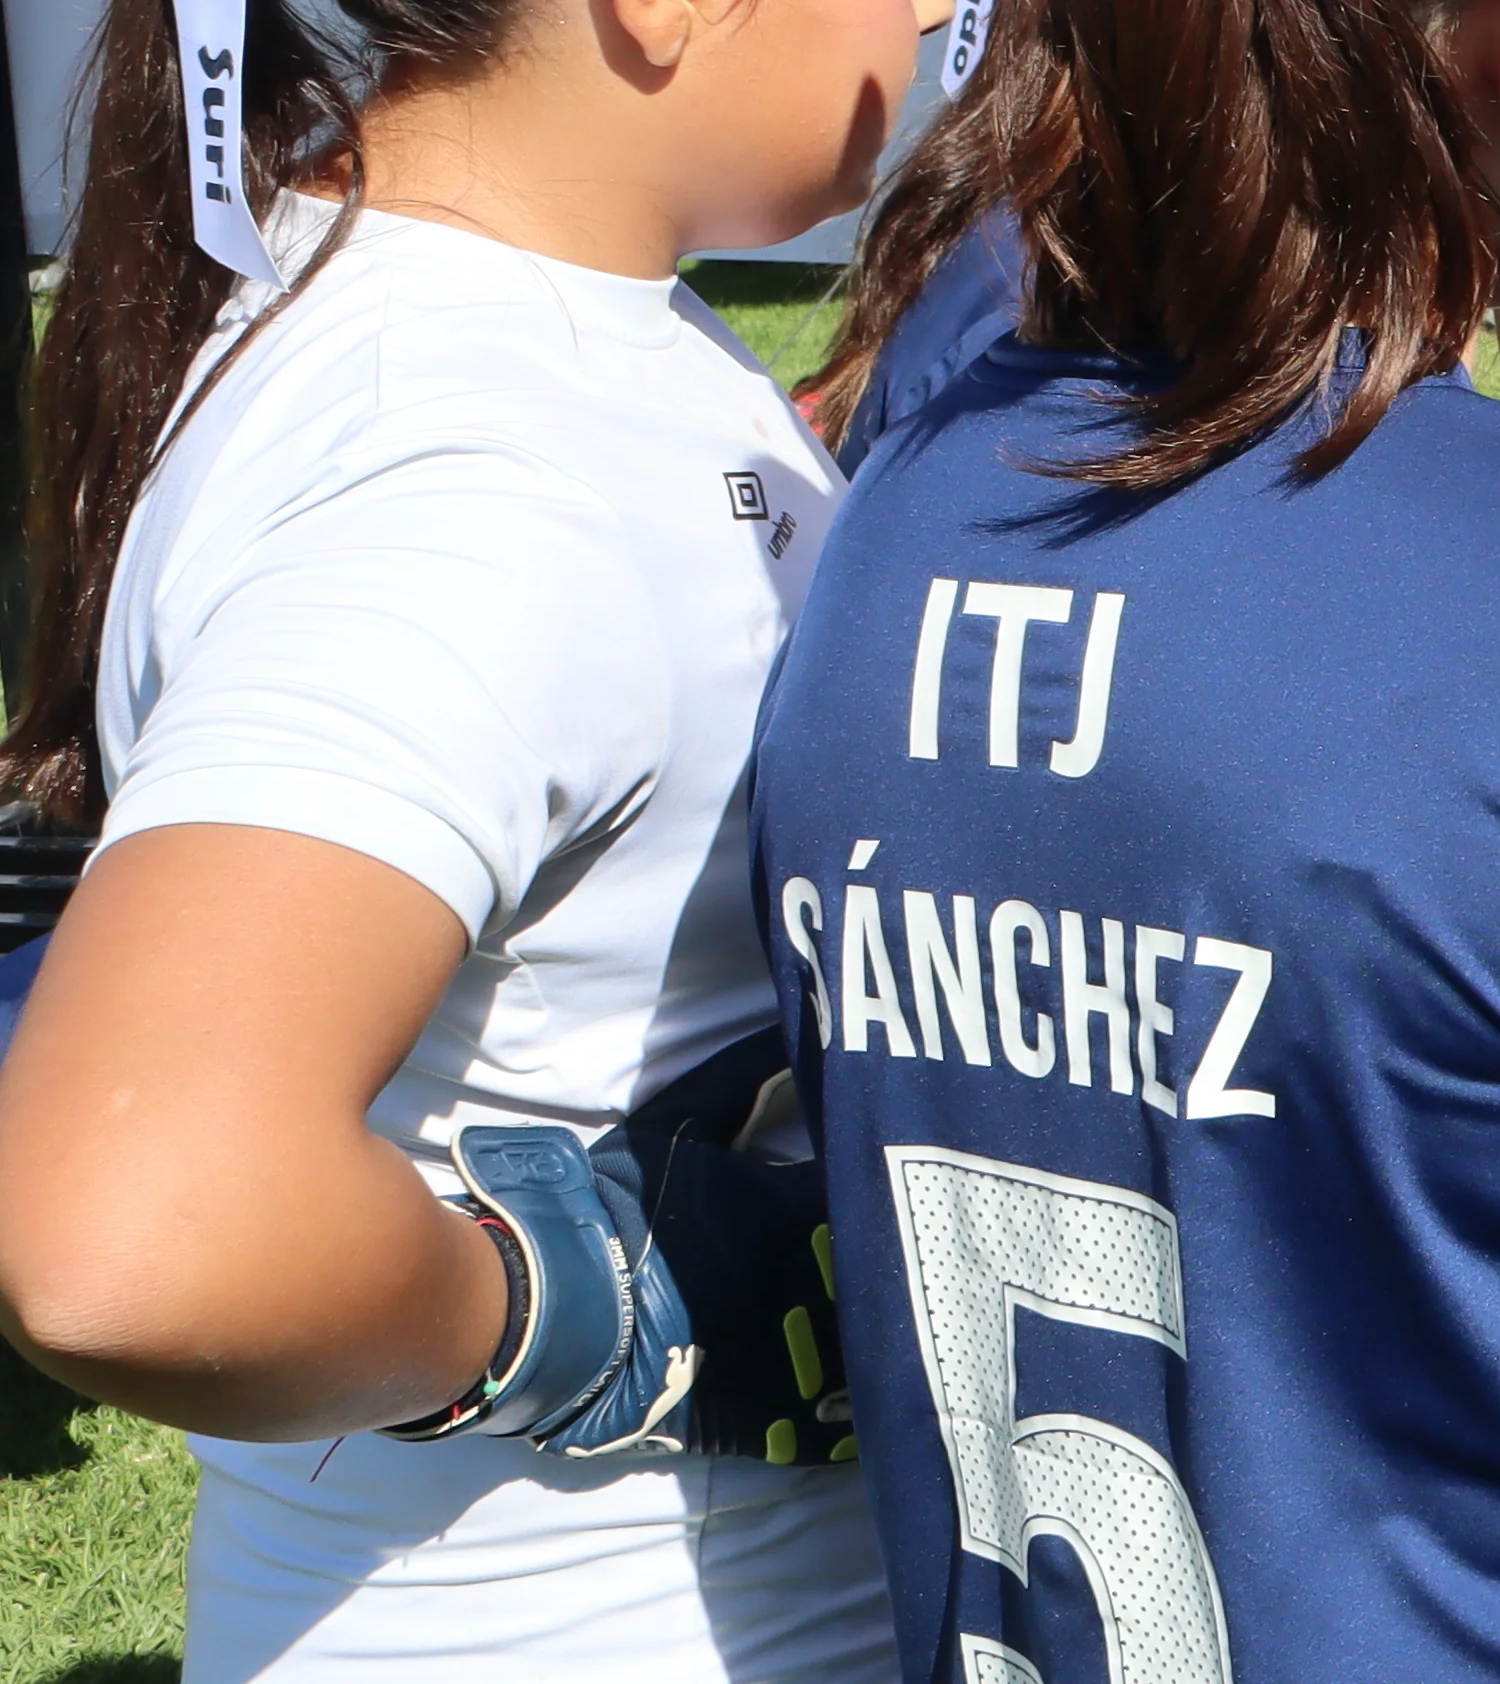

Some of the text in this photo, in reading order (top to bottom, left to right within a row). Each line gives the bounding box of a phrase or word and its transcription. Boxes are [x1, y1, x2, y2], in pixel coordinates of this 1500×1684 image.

[197, 44, 235, 205] Suri
[907, 576, 1127, 780] ITJ
[781, 839, 1276, 1121] SÁNCHEZ
[608, 1235, 630, 1272] 3MM
[884, 1144, 1236, 1684] 5
